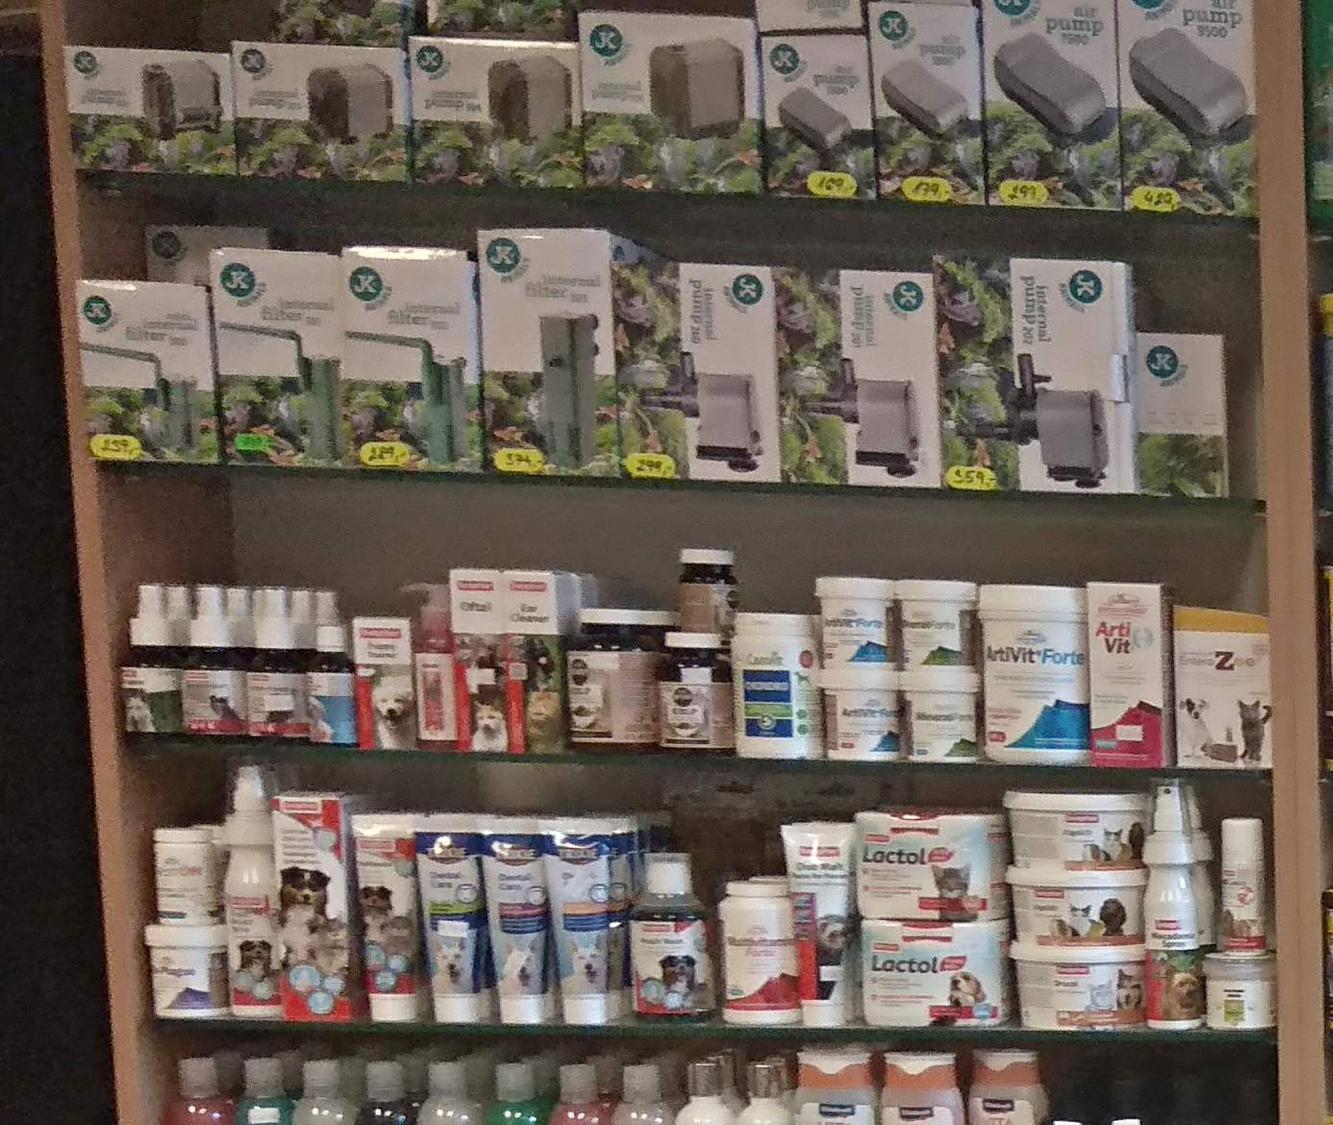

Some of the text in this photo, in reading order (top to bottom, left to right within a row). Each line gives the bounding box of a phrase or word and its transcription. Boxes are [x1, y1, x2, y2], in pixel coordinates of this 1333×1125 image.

[1046, 16, 1104, 36] pump
[1183, 7, 1244, 27] pump
[690, 280, 703, 321] pump
[850, 285, 864, 327] pump
[1021, 275, 1036, 322] pump
[1036, 284, 1051, 343] internal
[1096, 621, 1131, 639] Arti
[1104, 636, 1130, 655] Vit
[863, 847, 926, 864] Lactol
[871, 955, 939, 974] Lactol
